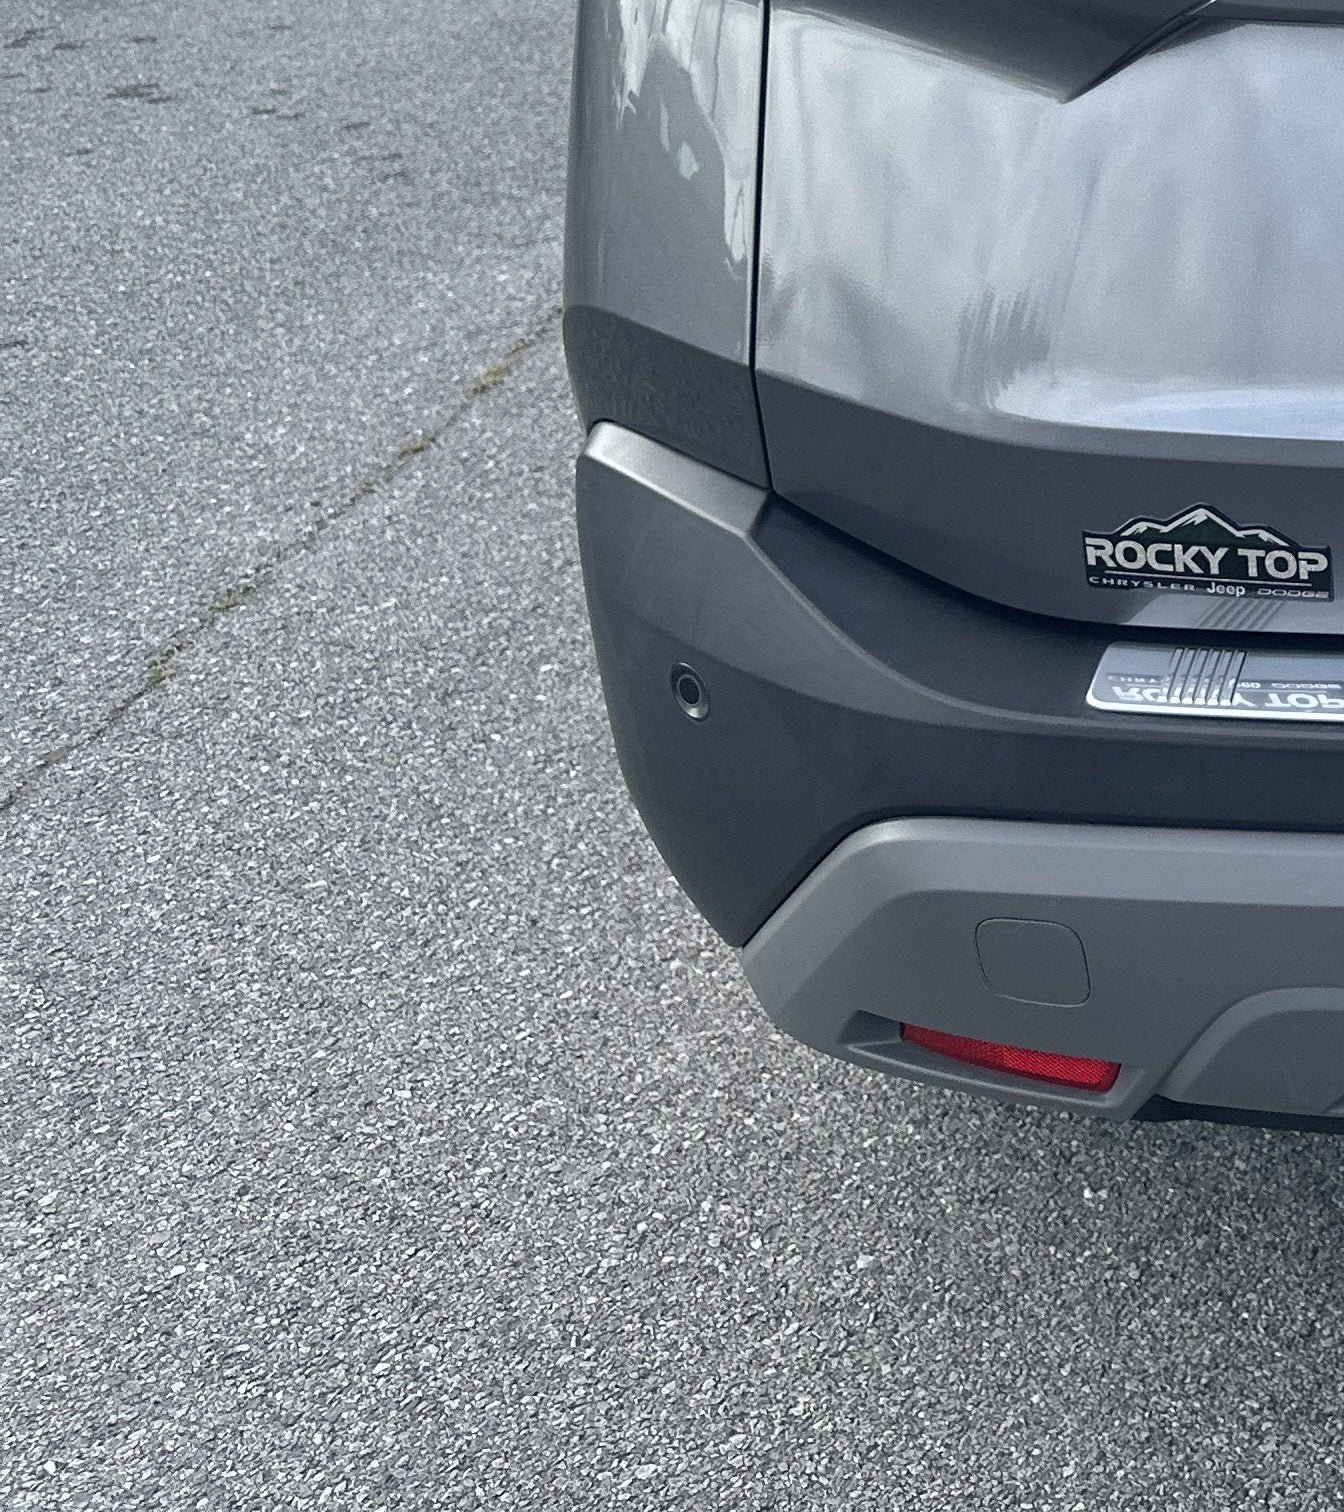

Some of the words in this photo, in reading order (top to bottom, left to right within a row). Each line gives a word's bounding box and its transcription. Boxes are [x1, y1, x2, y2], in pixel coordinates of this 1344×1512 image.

[1085, 536, 1230, 576] ROCKY
[1237, 547, 1329, 581] TOP
[1088, 575, 1197, 592] CHRYSLER
[1206, 581, 1246, 598] Jeep
[1256, 587, 1330, 600] DODGE
